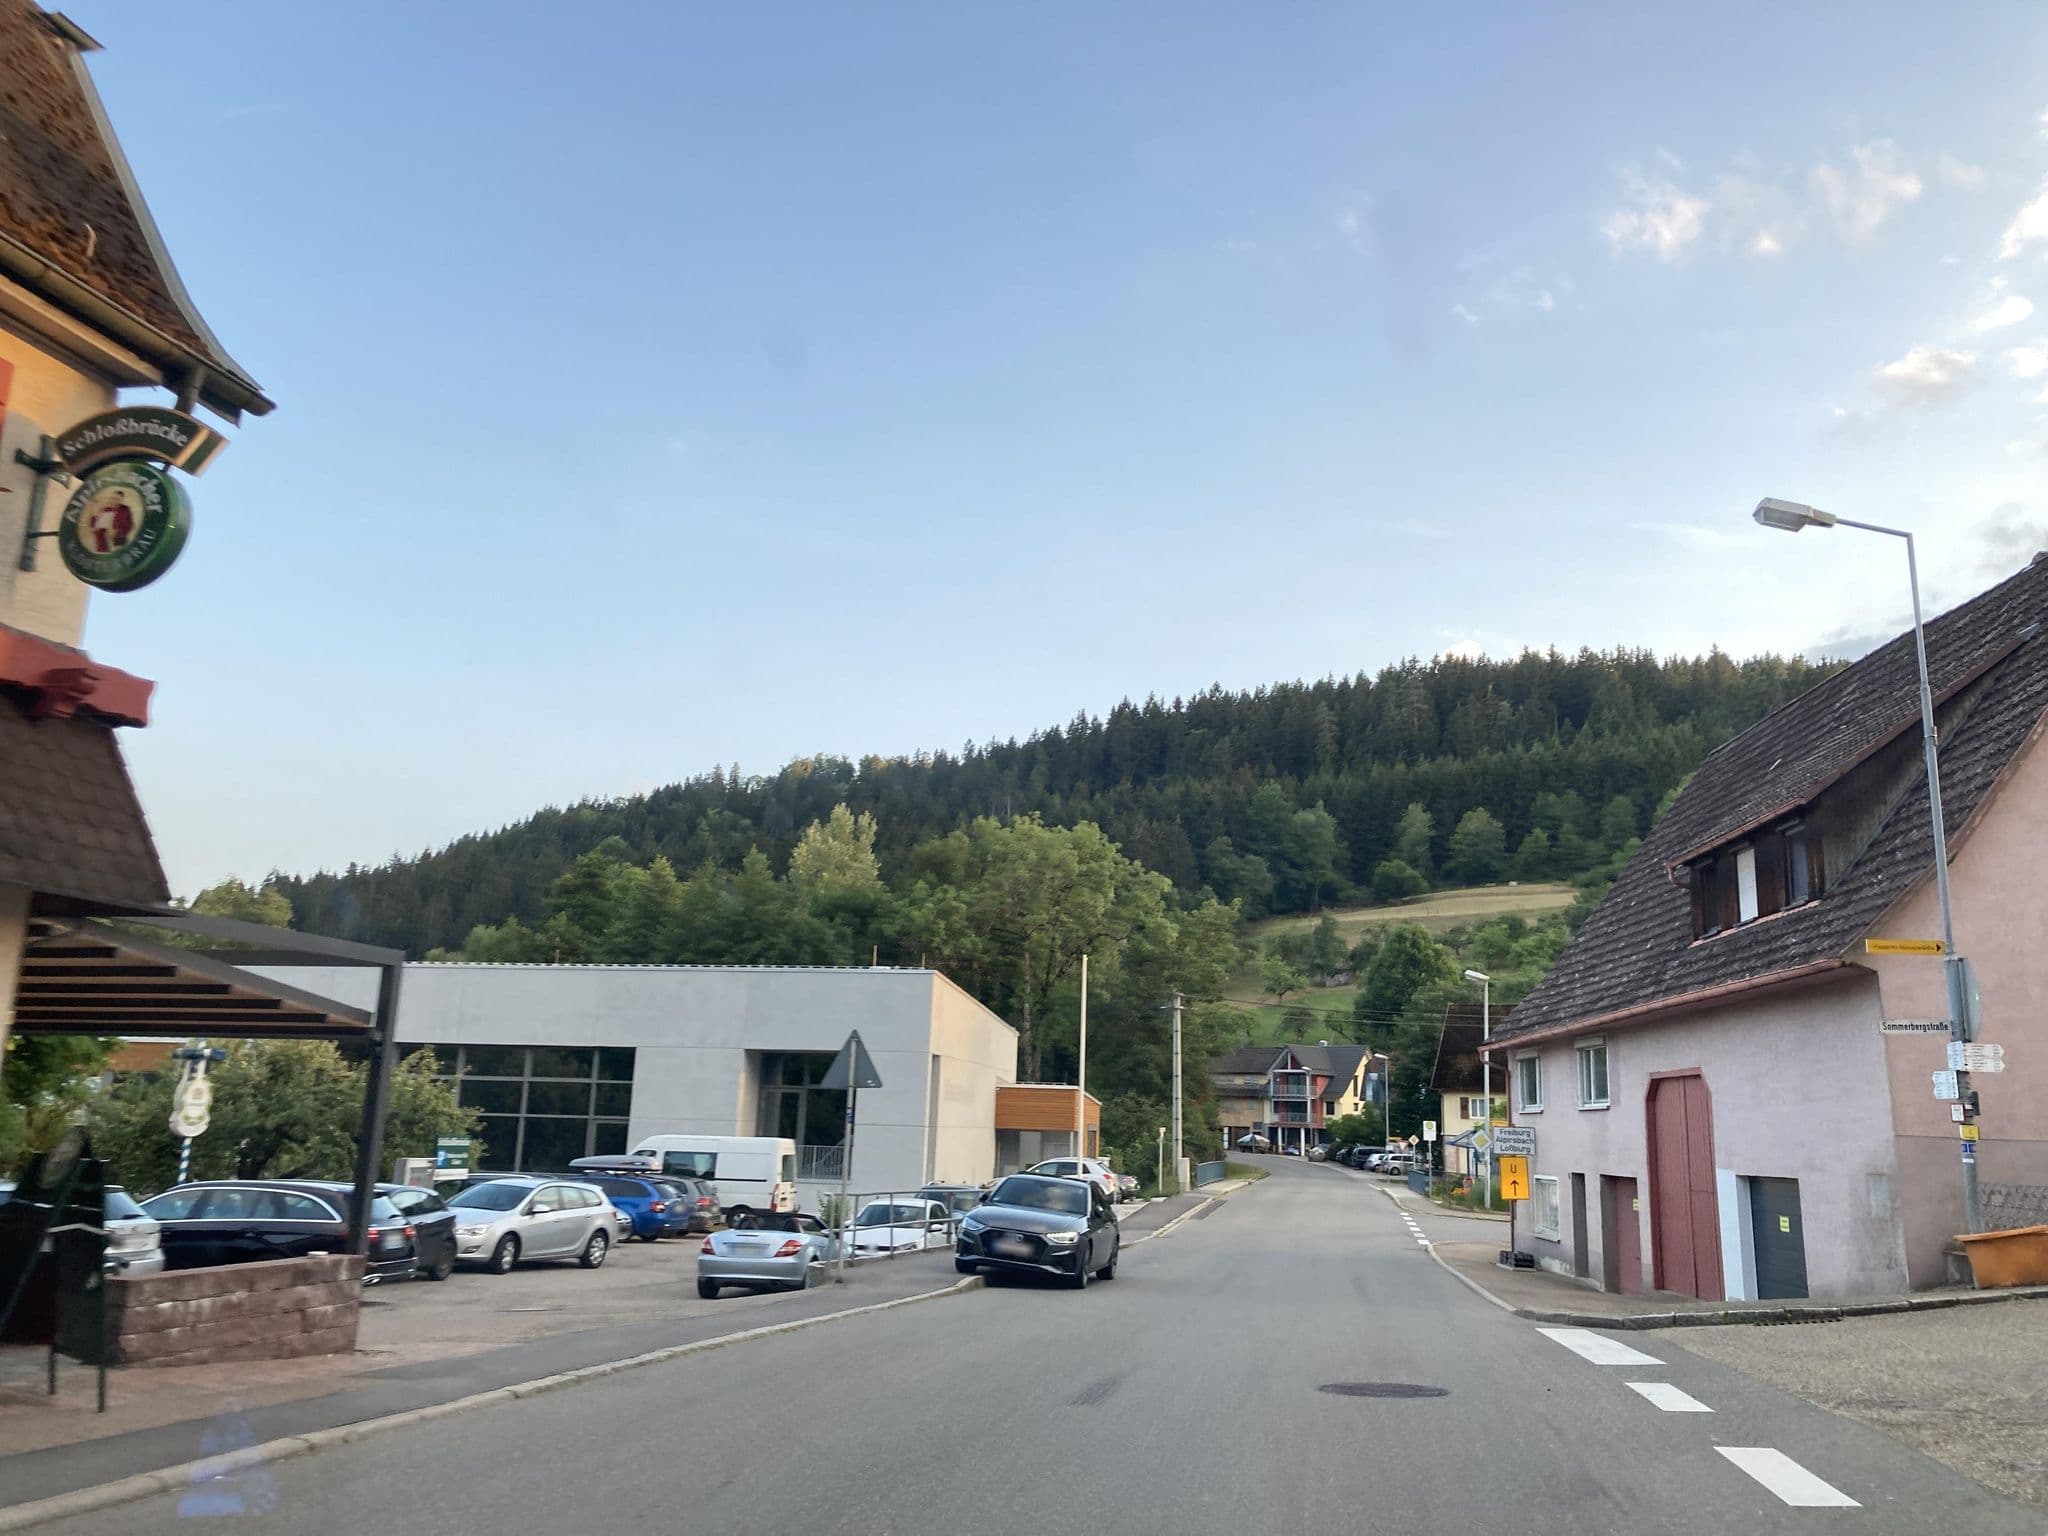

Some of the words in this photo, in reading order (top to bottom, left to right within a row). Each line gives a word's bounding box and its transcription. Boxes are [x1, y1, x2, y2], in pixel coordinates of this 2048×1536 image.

[63, 416, 190, 457] Schloßbrücke
[1882, 1021, 1949, 1033] Sommerbergstraße
[1499, 1128, 1531, 1137] Freiburg
[1496, 1136, 1535, 1145] Alpirsbach
[1500, 1144, 1531, 1153] Loßburg
[1510, 1164, 1517, 1173] U
